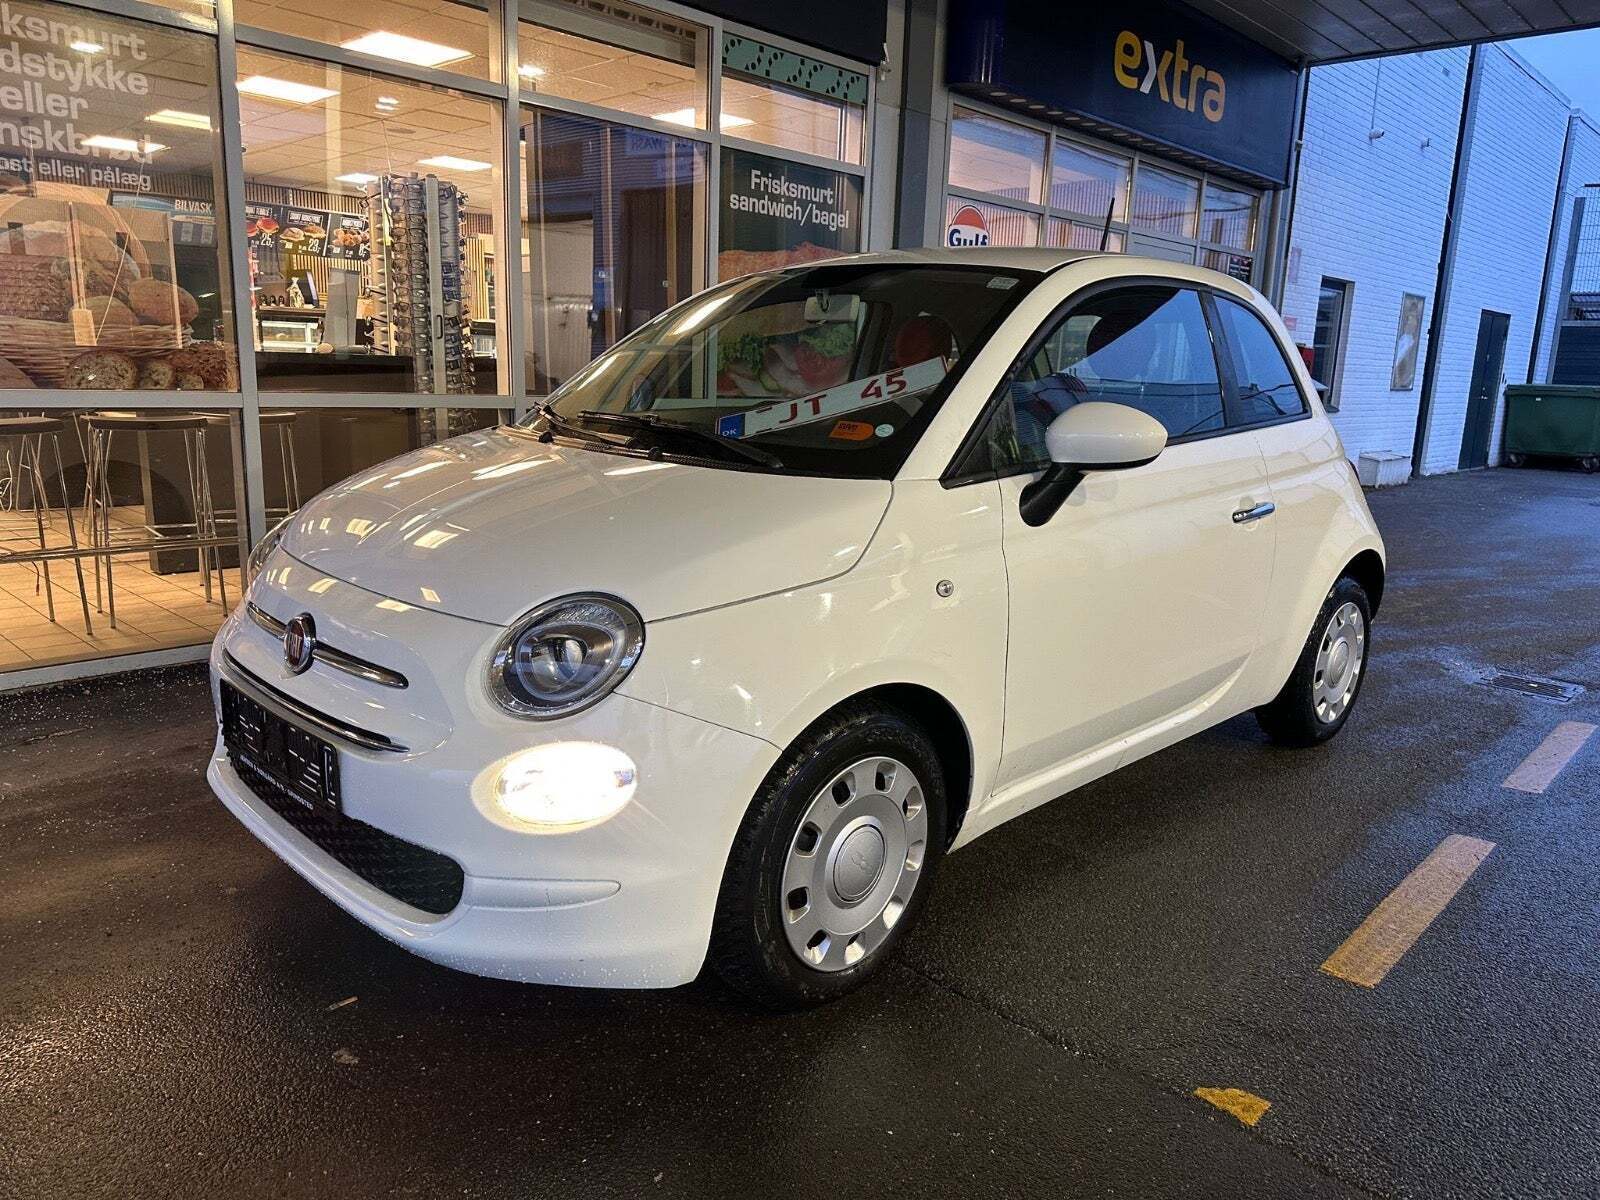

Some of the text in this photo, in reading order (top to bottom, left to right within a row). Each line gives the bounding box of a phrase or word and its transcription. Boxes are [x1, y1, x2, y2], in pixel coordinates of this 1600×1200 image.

[0, 2, 148, 61] ksmurt
[0, 41, 149, 96] dstykke
[1114, 30, 1226, 123] extra
[0, 80, 89, 120] eller
[39, 159, 85, 179] eller
[91, 167, 152, 192] pålæg
[750, 169, 834, 205] Frisksmurt
[174, 199, 213, 216] BILVASK
[729, 193, 849, 232] sandwich/bagel
[948, 228, 988, 247] Gulf
[778, 369, 908, 424] JT 45
